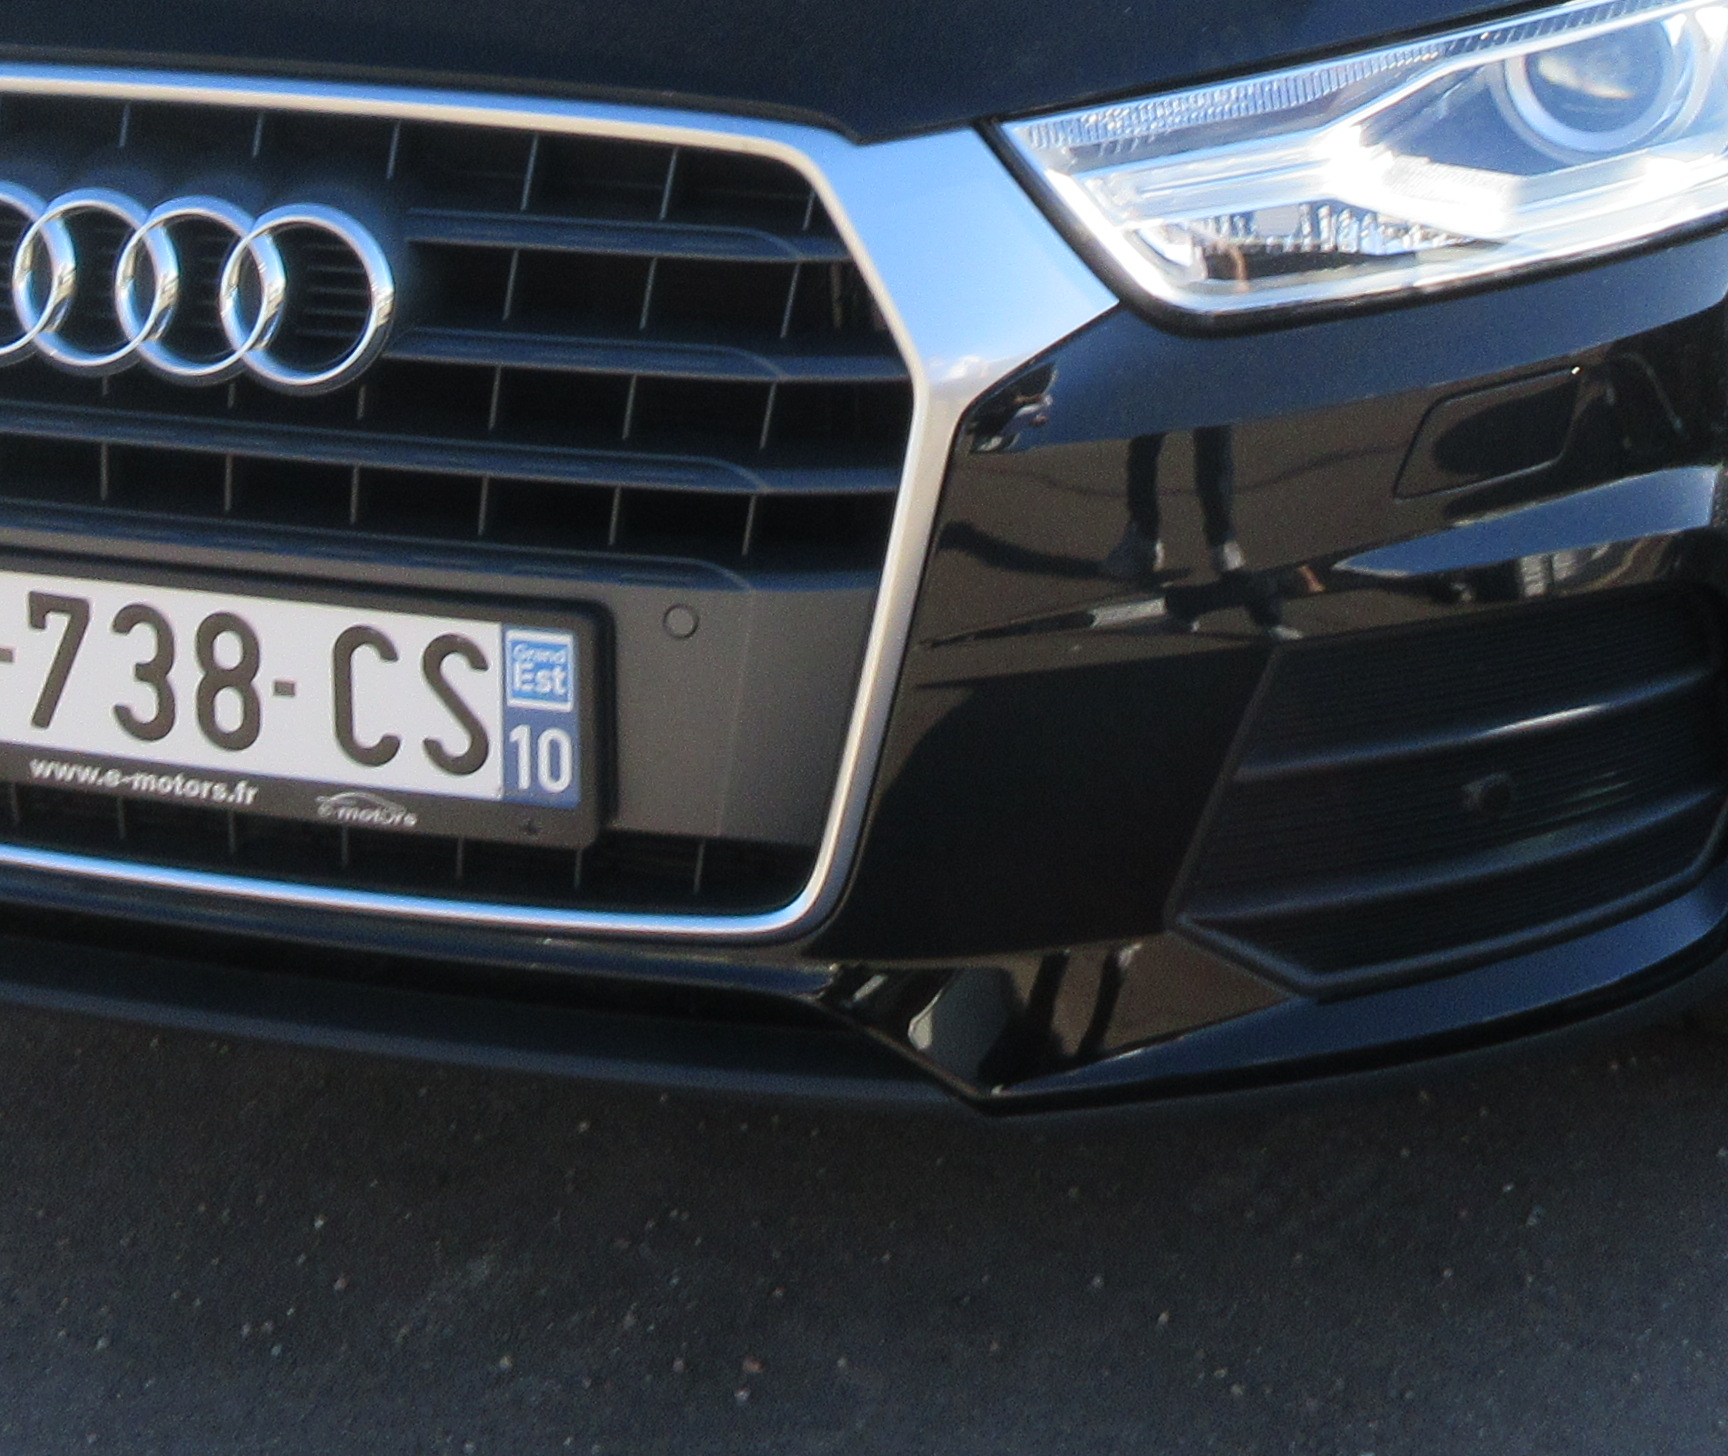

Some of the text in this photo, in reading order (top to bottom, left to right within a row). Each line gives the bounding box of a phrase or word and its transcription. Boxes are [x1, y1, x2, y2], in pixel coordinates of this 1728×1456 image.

[514, 661, 567, 694] Est
[29, 757, 260, 805] www.e-motors.fr
[509, 723, 572, 794] 10
